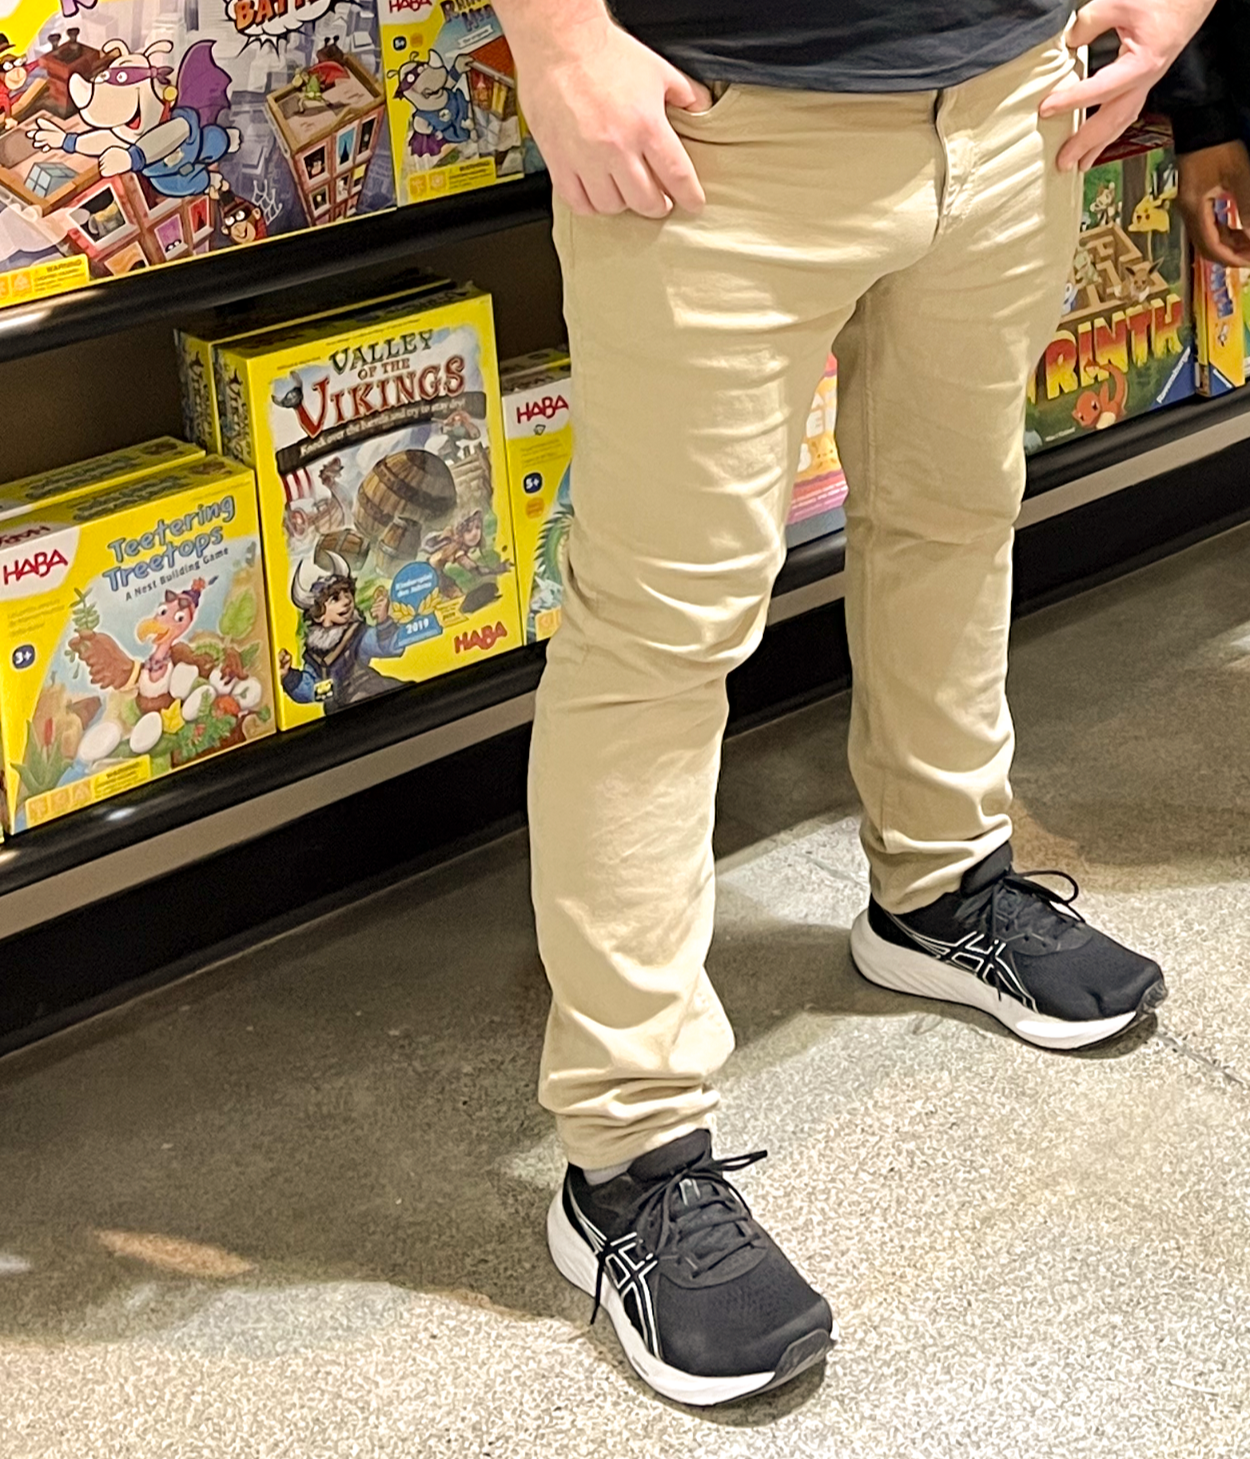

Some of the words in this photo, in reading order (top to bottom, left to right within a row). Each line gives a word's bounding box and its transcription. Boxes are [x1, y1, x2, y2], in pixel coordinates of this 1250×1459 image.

[329, 328, 434, 375] VALLEY
[357, 366, 377, 381] OF
[381, 357, 411, 374] THE
[294, 354, 466, 439] VIKINGS
[516, 395, 570, 425] HABA
[525, 476, 540, 490] 5+
[107, 495, 236, 563] Teetering
[3, 549, 69, 586] HABA
[102, 525, 224, 592] Treetops
[125, 591, 133, 602] A
[134, 580, 158, 597] Nest
[160, 562, 201, 586] Building
[202, 547, 230, 565] Game
[454, 621, 508, 654] HABA
[15, 650, 33, 665] 3+
